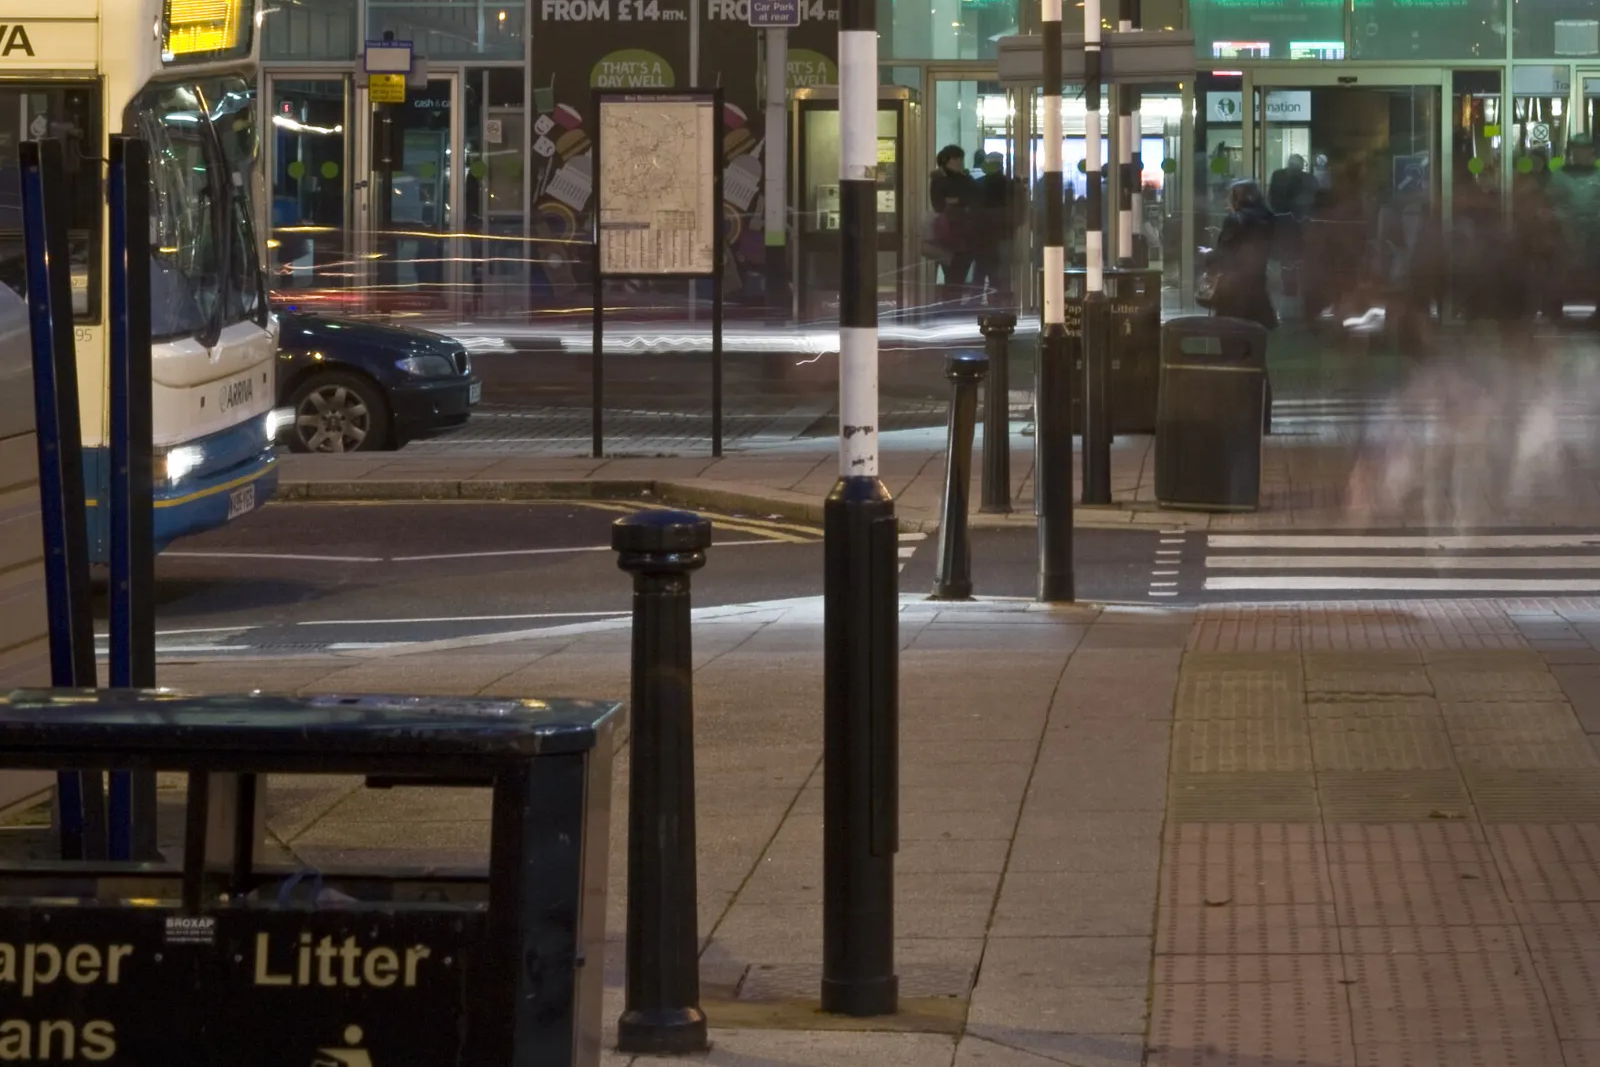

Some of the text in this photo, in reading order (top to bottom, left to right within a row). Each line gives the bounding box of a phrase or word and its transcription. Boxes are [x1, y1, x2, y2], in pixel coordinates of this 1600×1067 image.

[541, 0, 688, 21] FROM £14 RTN.
[708, 0, 749, 21] FRO
[800, 0, 825, 21] 14
[754, 2, 794, 11] Car Park
[759, 13, 768, 21] at
[602, 61, 662, 75] THAT'S A
[787, 61, 827, 75] AT'S A
[598, 75, 666, 87] DAY WELL
[414, 99, 434, 108] cash
[1110, 303, 1140, 315] Litter
[166, 917, 215, 928] BROXAP
[254, 931, 431, 987] Litter
[0, 1018, 118, 1061] ans
